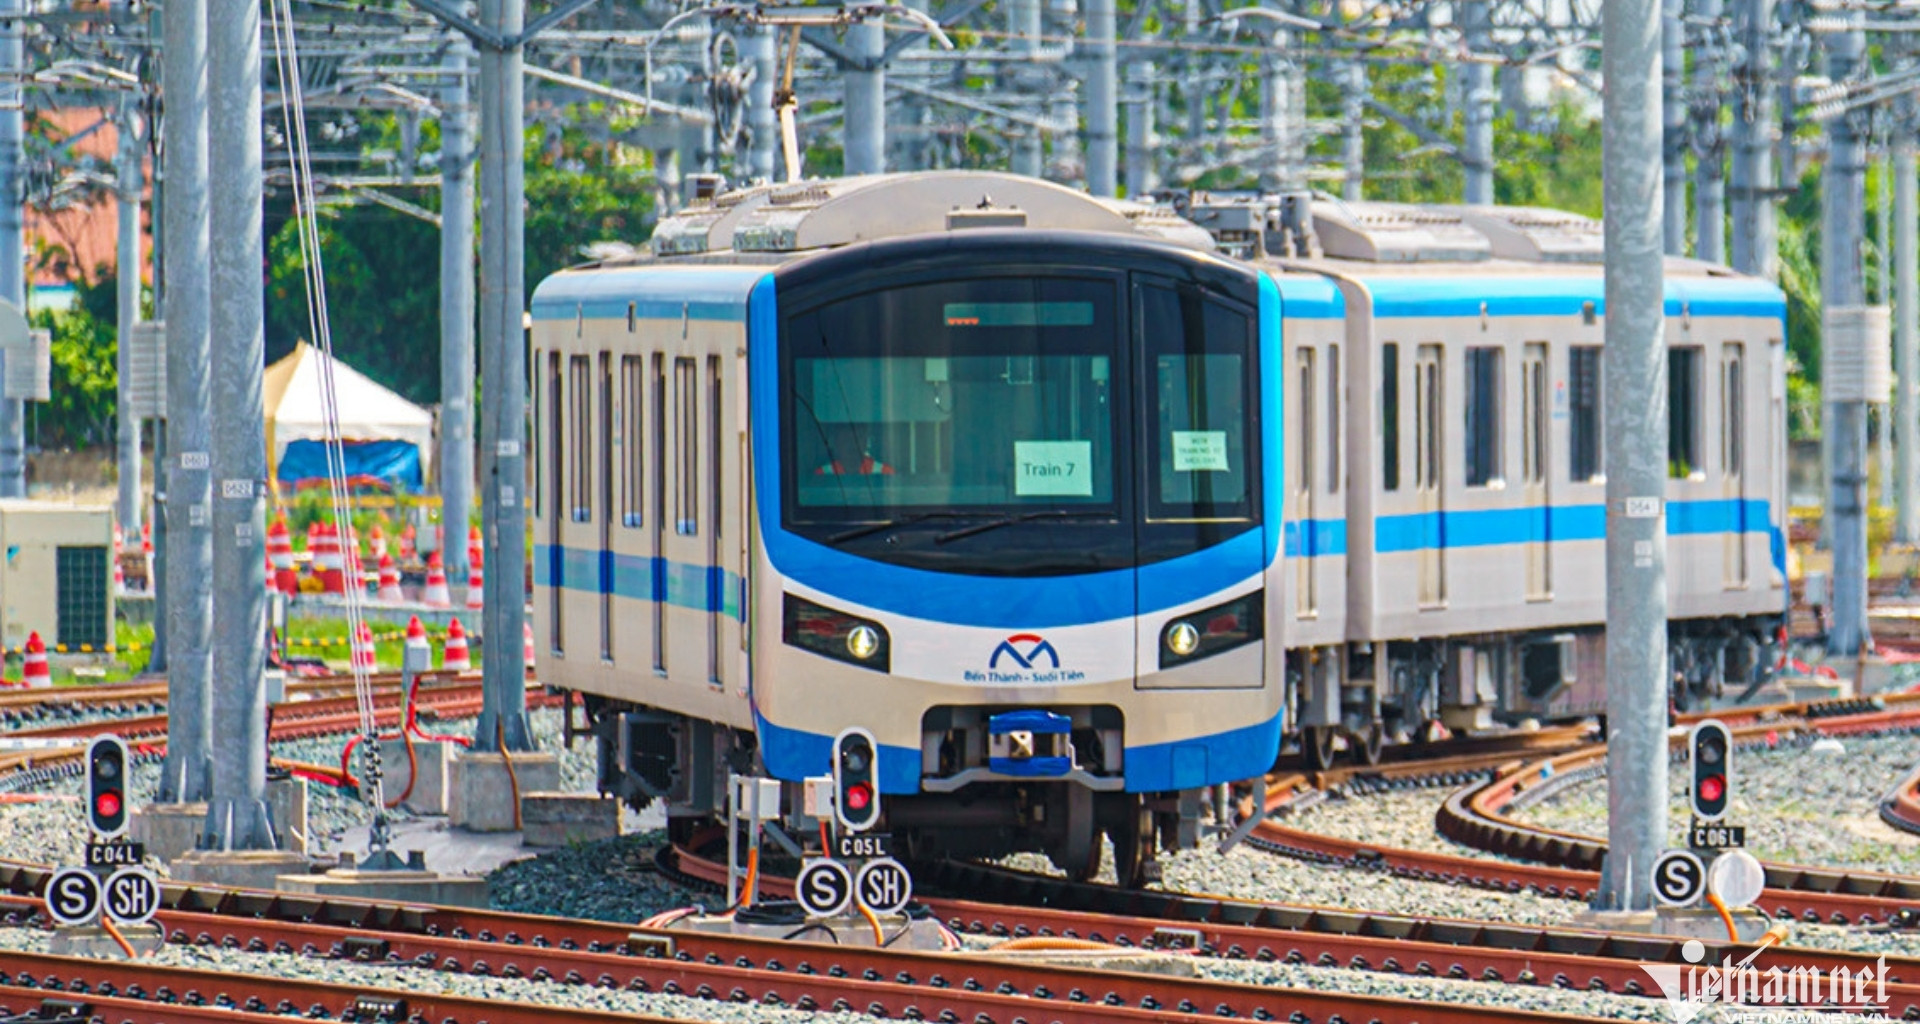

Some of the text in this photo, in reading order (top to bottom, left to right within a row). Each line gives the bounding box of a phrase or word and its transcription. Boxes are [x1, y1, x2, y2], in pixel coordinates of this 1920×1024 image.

[1024, 463, 1075, 476] Train 7
[60, 877, 87, 914] S
[114, 878, 148, 915] SH
[811, 869, 837, 906] S
[867, 869, 900, 906] SH
[1664, 859, 1691, 897] S
